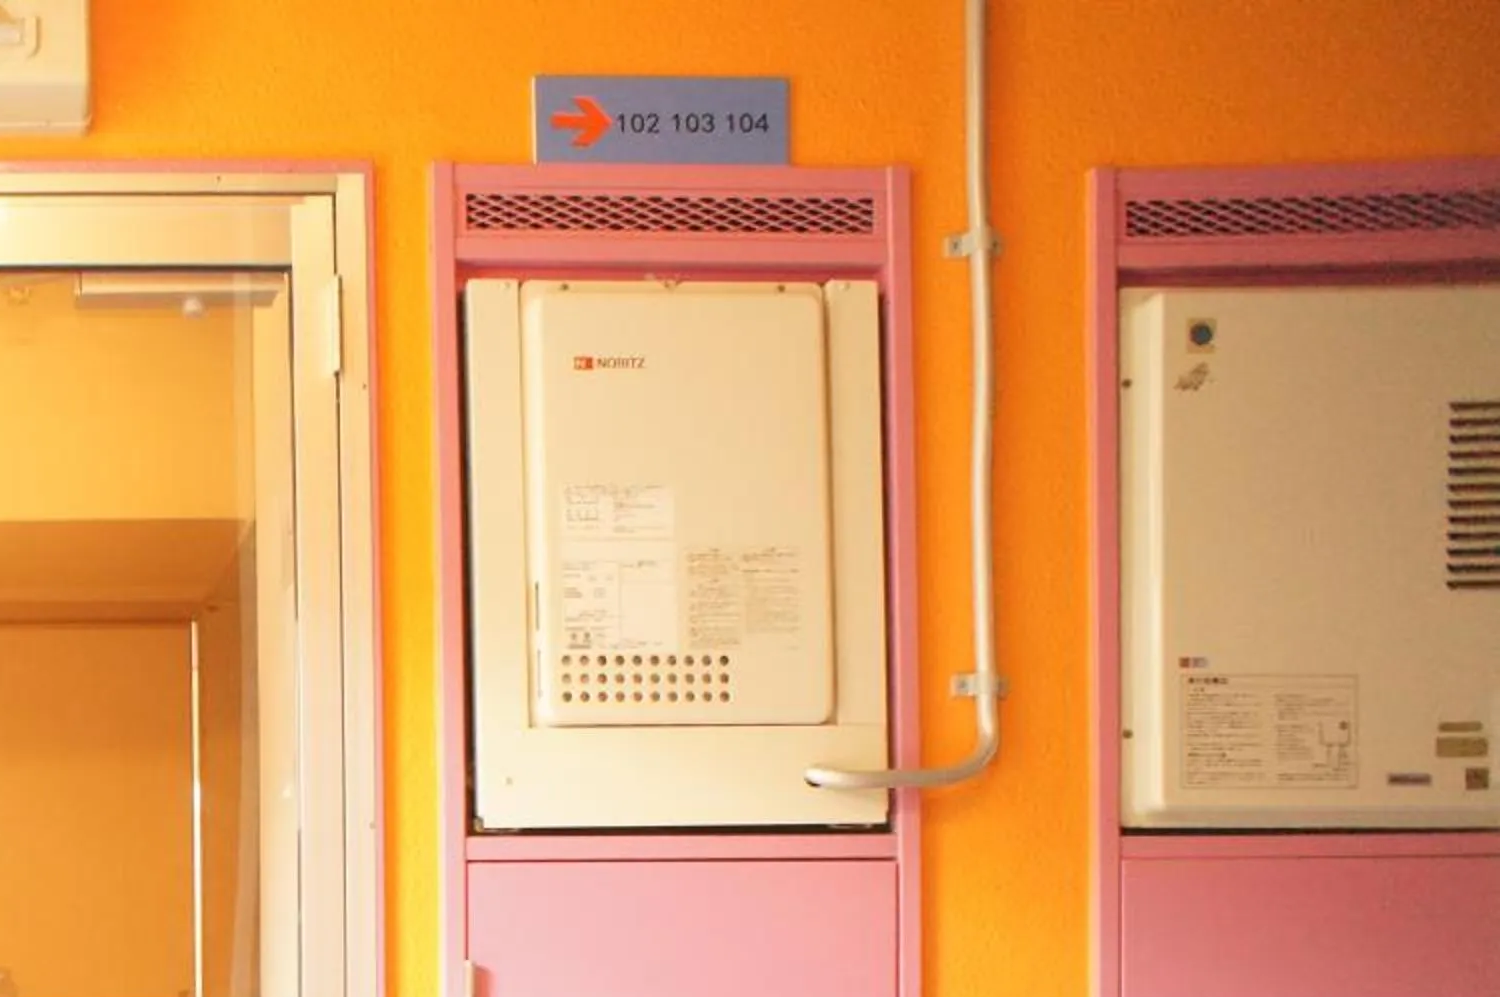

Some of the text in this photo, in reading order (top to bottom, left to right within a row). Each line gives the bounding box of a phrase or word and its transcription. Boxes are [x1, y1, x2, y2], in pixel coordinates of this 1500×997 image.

[617, 113, 770, 133] 102 103 104
